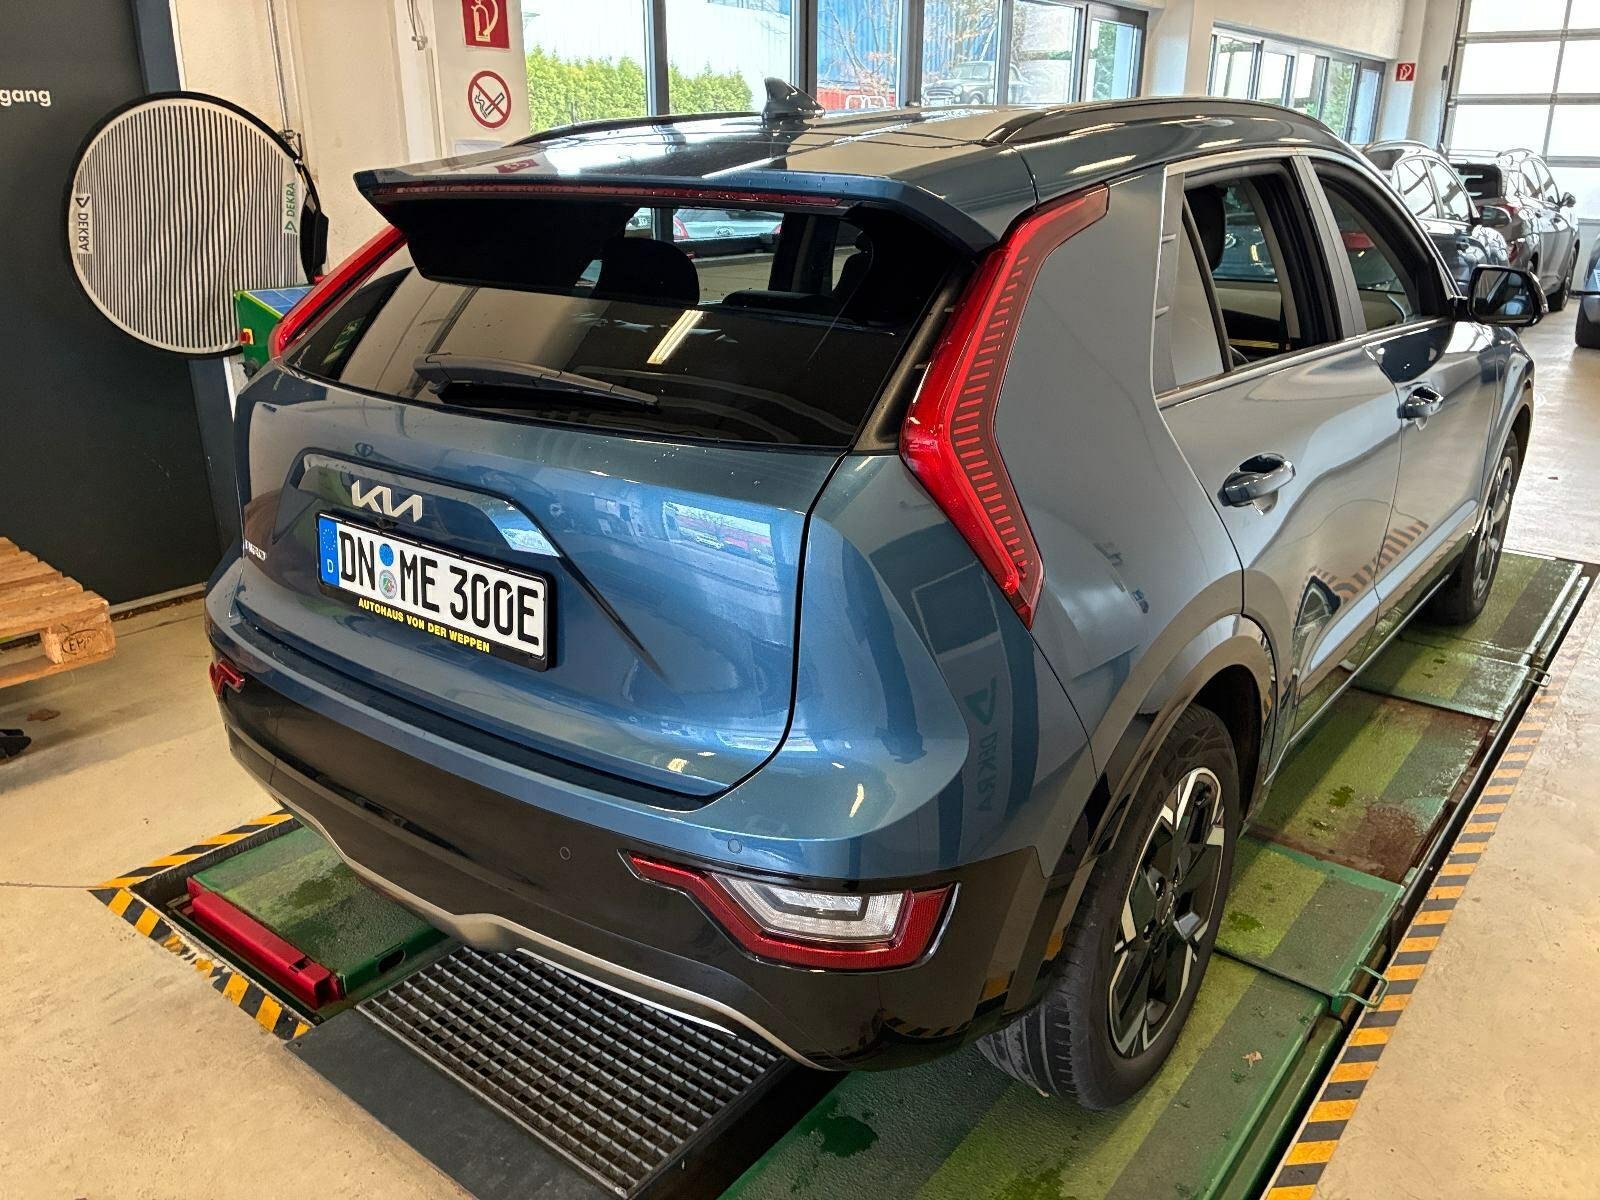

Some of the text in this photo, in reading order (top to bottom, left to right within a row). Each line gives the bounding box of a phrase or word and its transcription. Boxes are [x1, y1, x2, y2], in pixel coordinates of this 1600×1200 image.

[285, 182, 296, 217] DEKRA
[326, 559, 334, 574] D
[338, 530, 539, 646] DN ME 300E
[358, 597, 490, 653] AUTOHAUS VON DER WEPPEN
